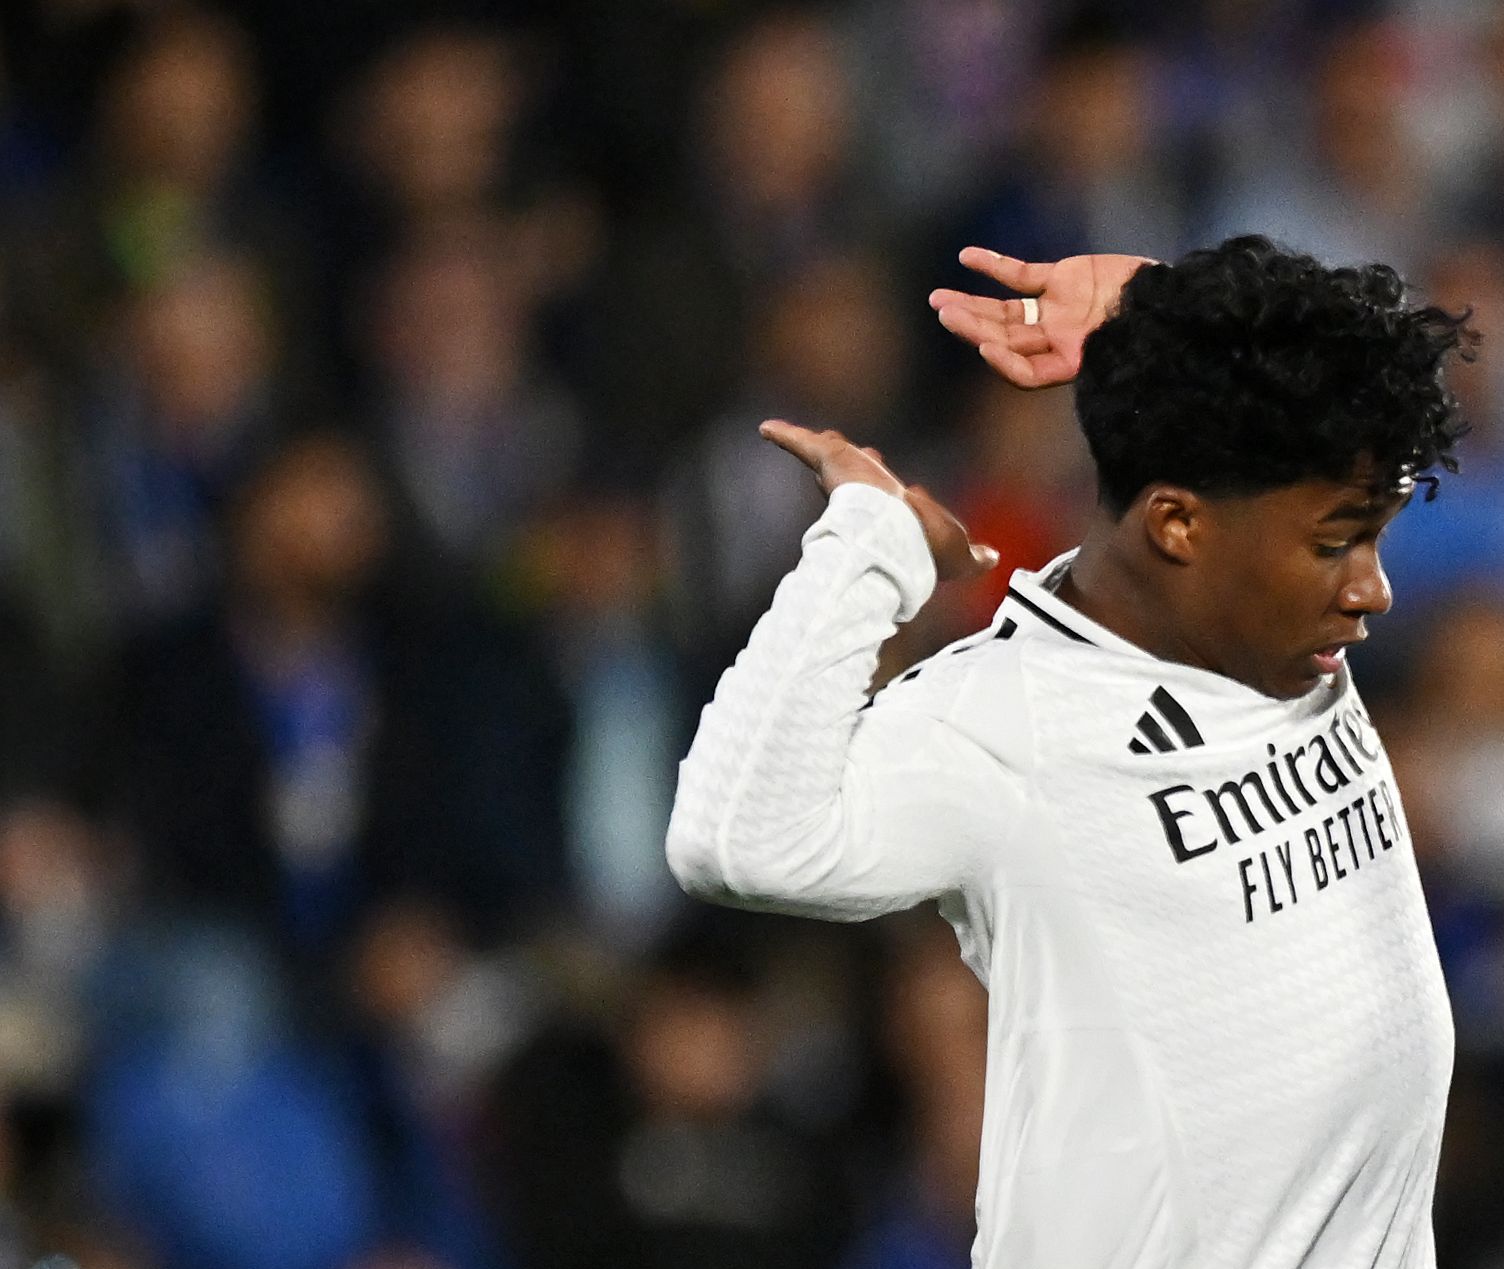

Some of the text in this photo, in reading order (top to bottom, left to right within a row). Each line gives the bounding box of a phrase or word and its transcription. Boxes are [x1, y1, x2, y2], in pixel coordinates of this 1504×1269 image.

[1147, 698, 1379, 864] Emirate
[1238, 779, 1403, 924] FLY BETTER
